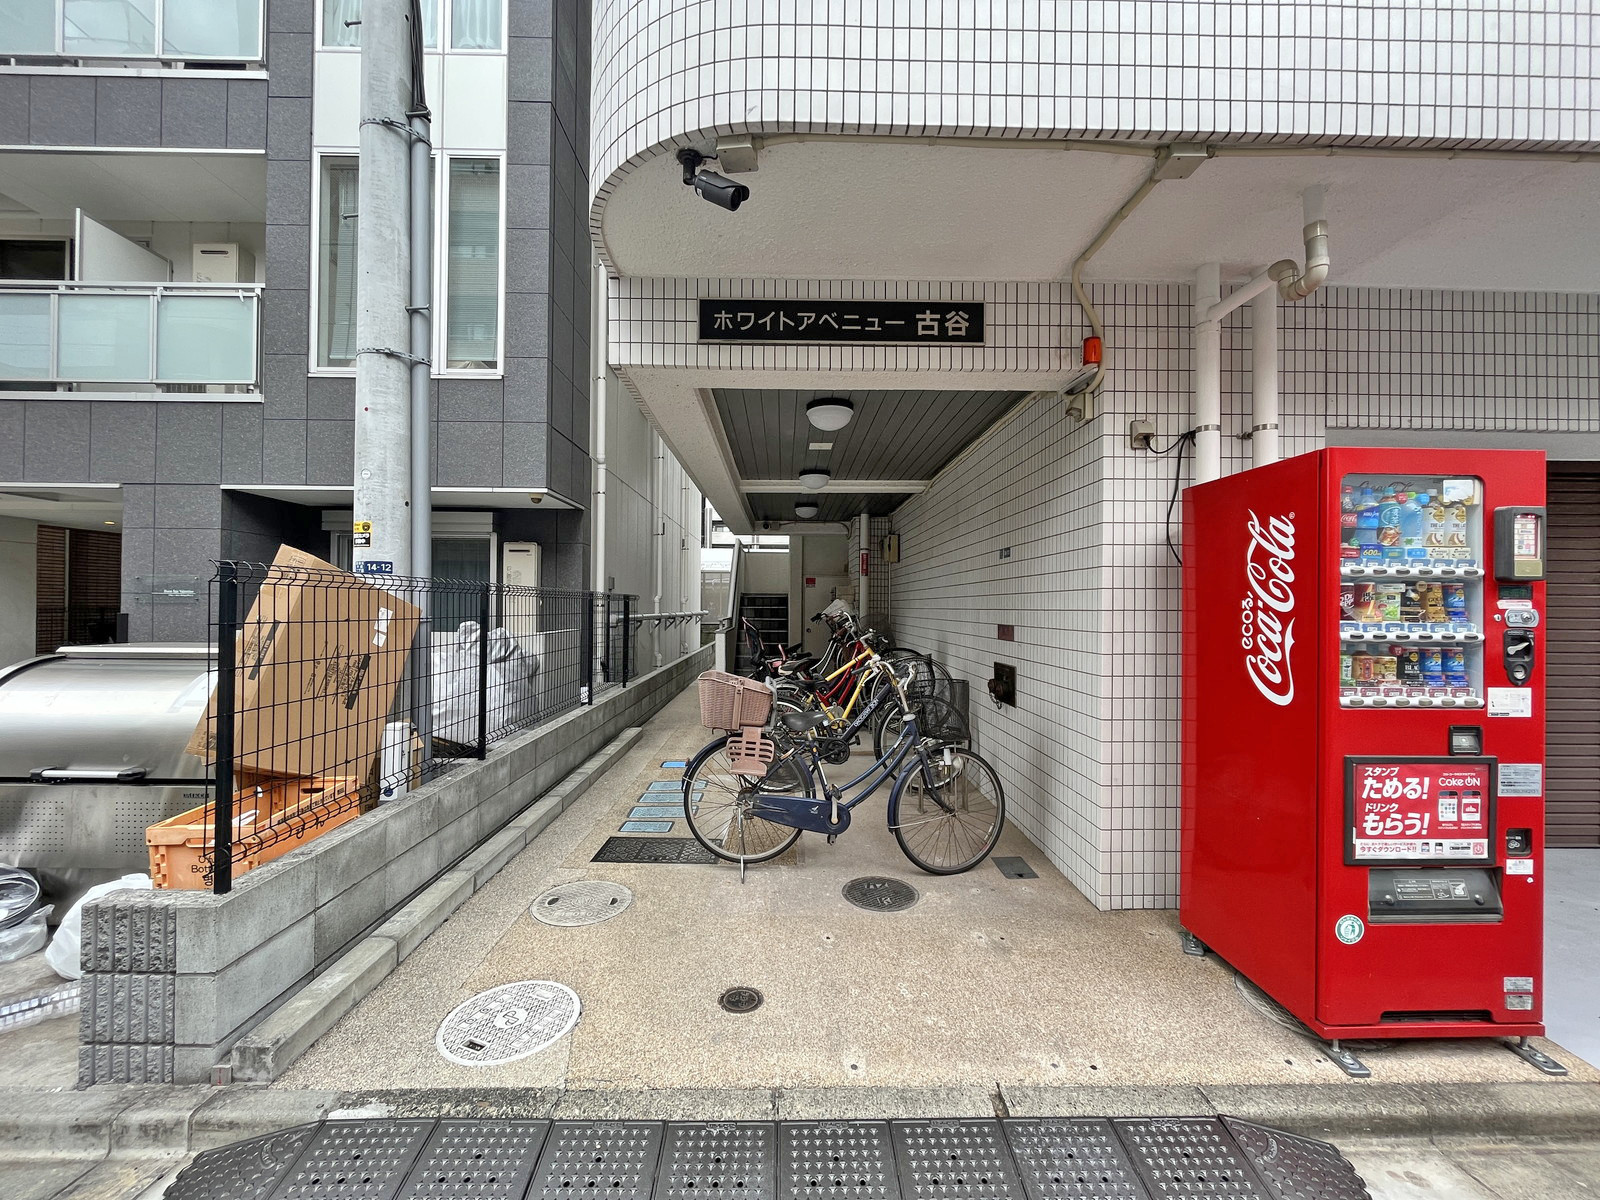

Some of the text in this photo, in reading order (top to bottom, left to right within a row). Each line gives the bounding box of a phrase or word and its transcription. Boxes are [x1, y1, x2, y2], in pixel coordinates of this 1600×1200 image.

[713, 310, 970, 336] ホワイトアベニュー 古谷
[367, 563, 392, 571] 14-12
[1245, 508, 1296, 706] Coca-Cola
[1364, 767, 1400, 777] スタンプ
[1438, 775, 1481, 787] Coke ON
[1361, 776, 1430, 800] ためる!
[1365, 803, 1399, 812] ドリンク
[1362, 812, 1430, 836] もらう!
